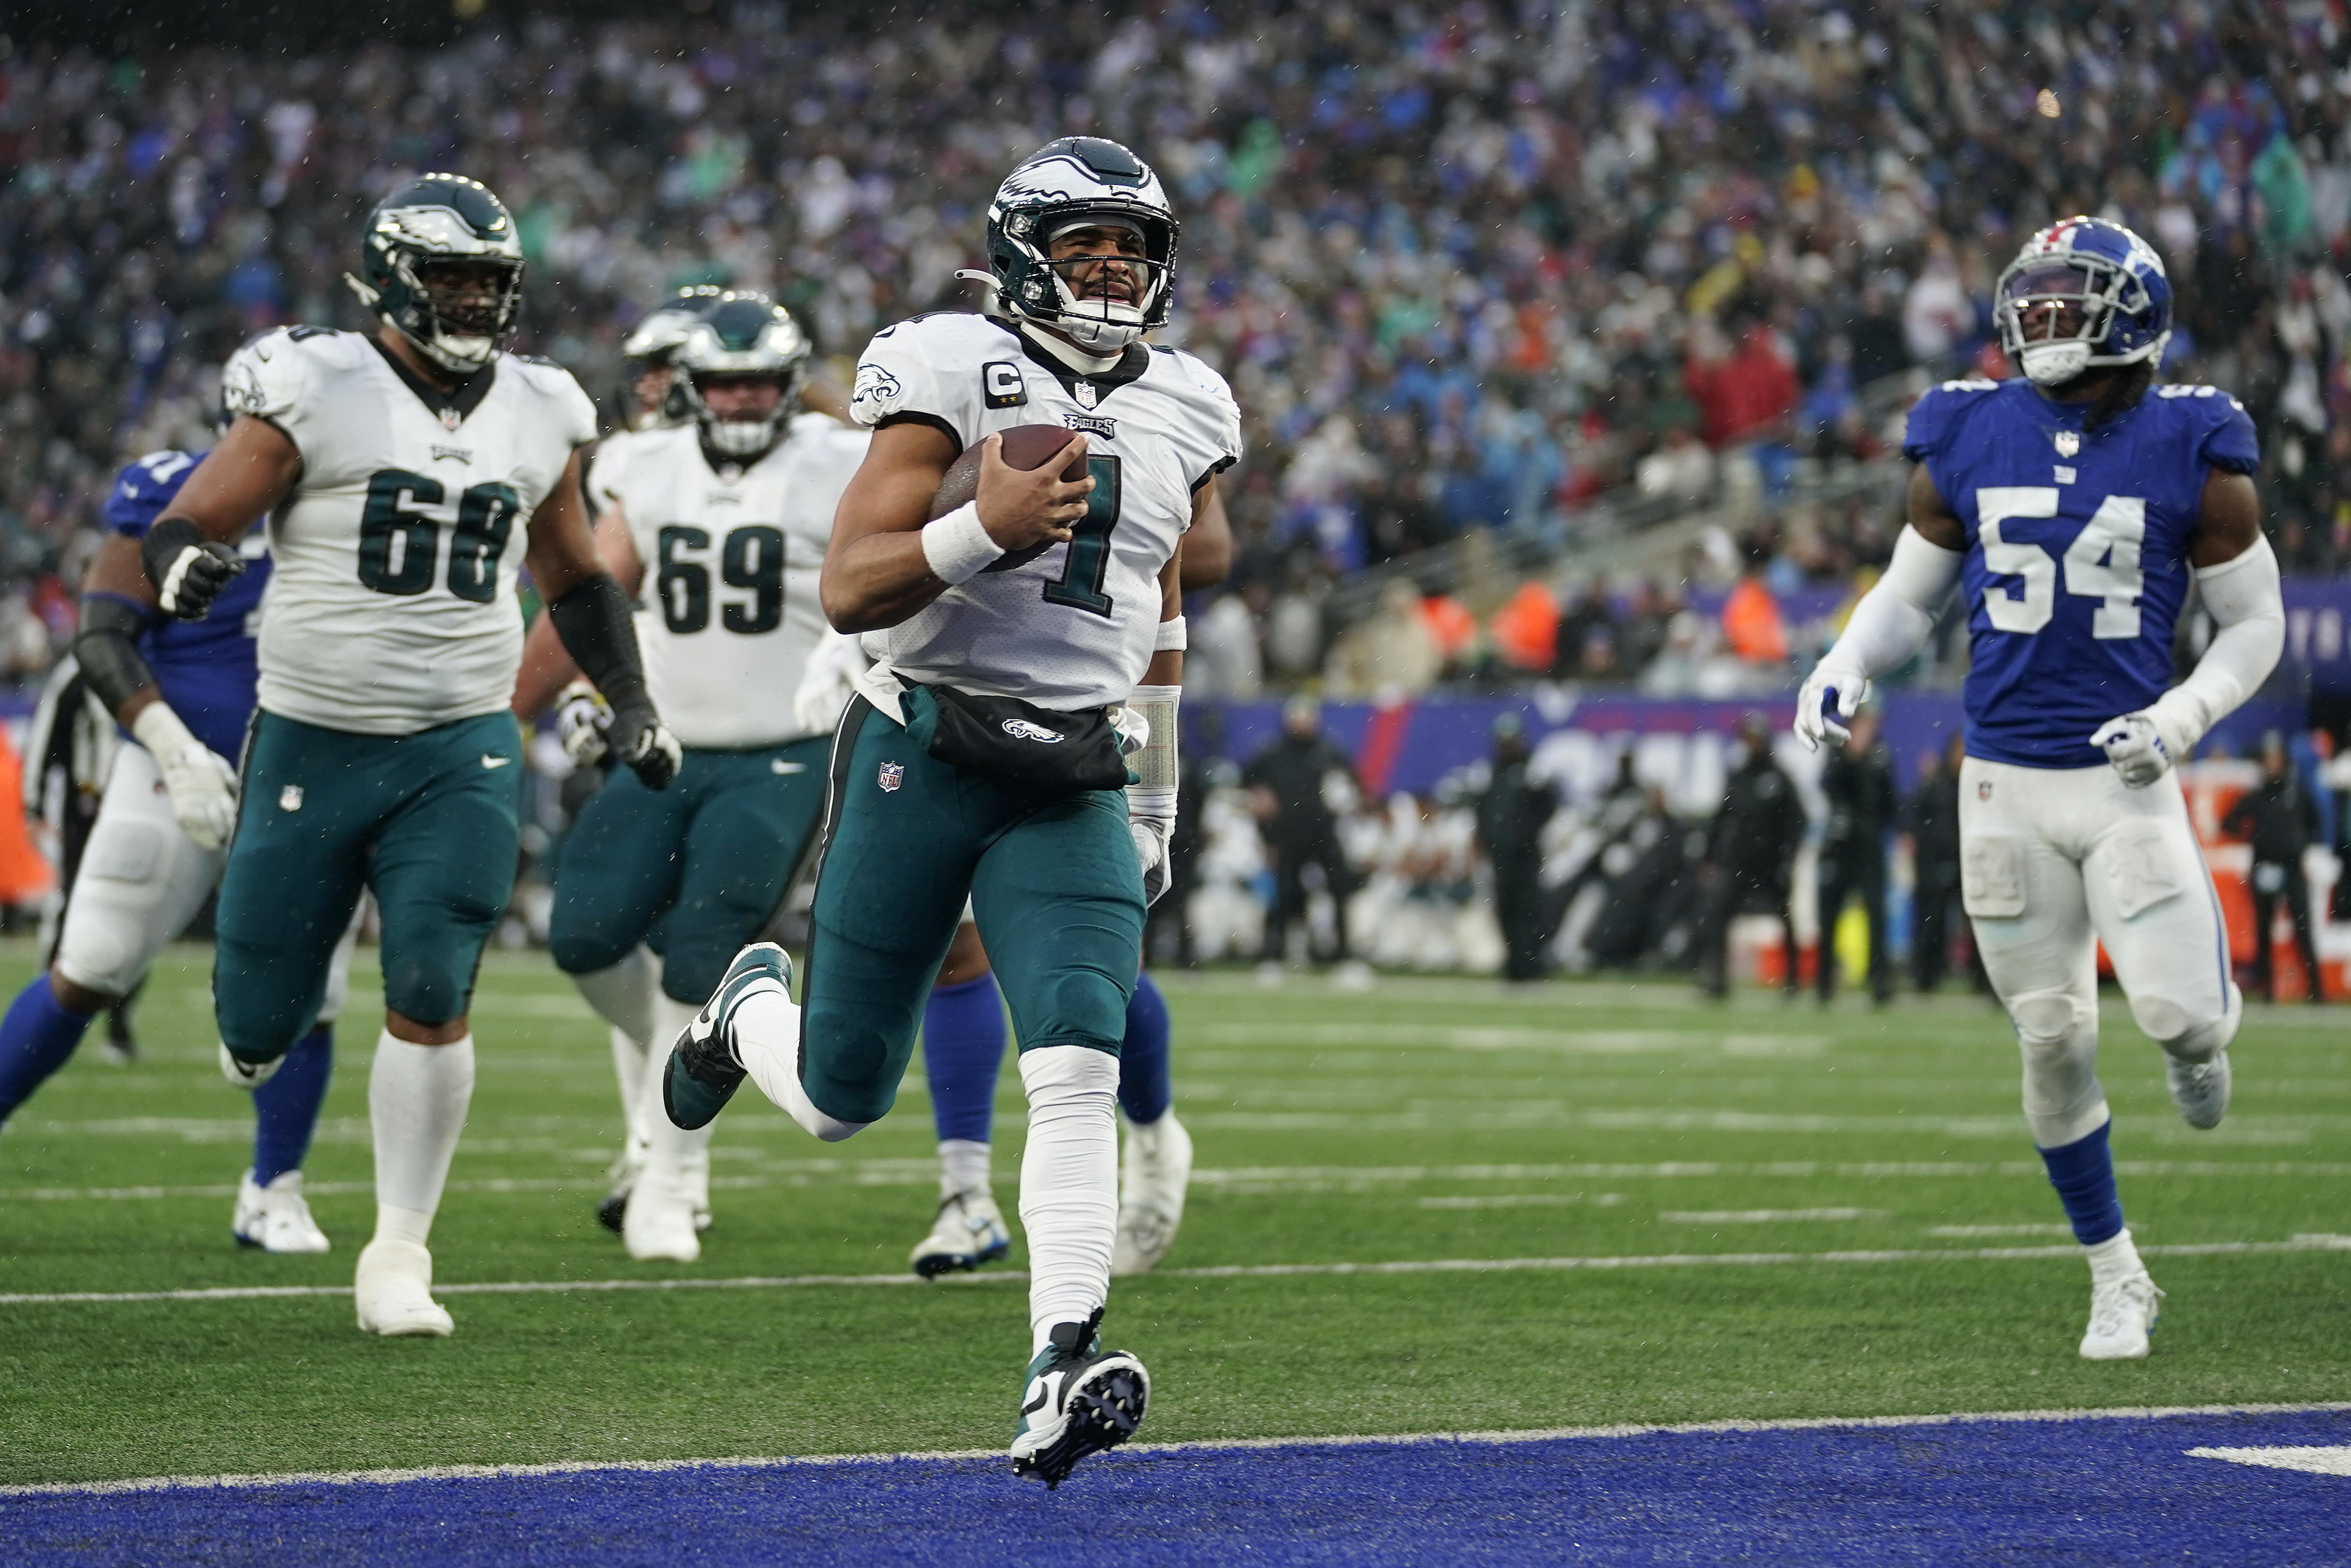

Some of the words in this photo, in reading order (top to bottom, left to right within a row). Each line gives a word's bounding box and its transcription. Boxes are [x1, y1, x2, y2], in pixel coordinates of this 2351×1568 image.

[987, 364, 1023, 396] C
[1064, 414, 1116, 438] EAGLES
[358, 469, 519, 603] 68
[657, 525, 785, 635] 69
[1042, 454, 1121, 619] 1
[1976, 487, 2146, 640] 54
[882, 774, 897, 786] NFL
